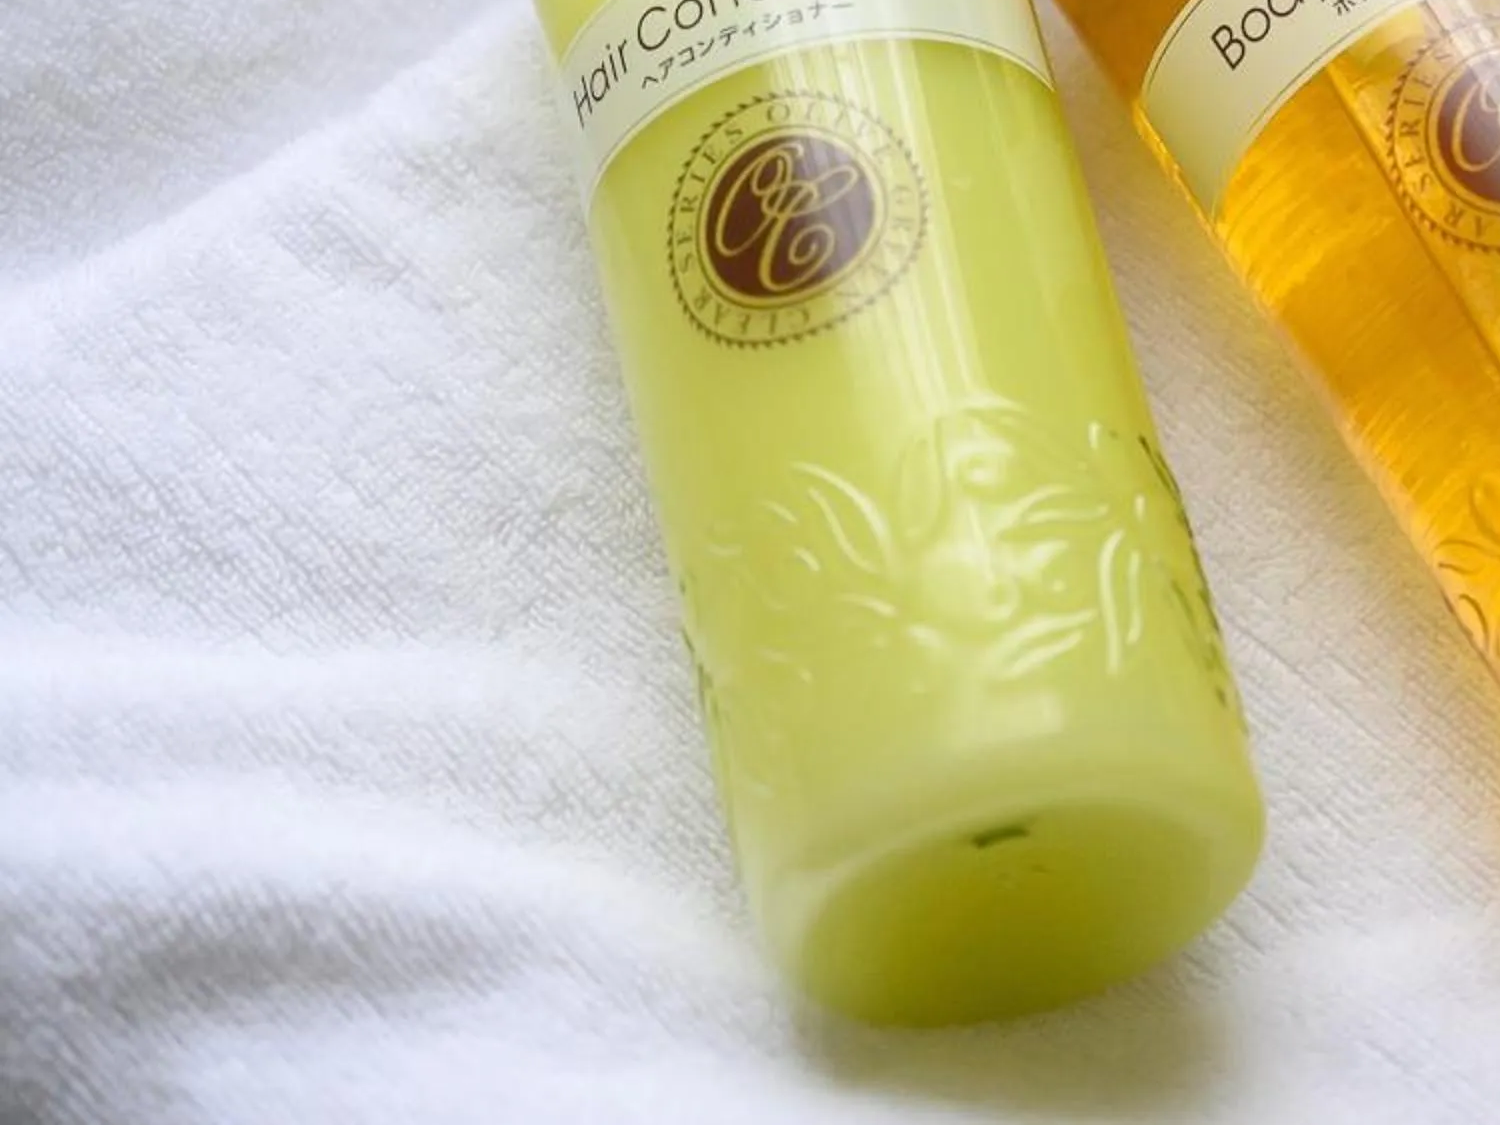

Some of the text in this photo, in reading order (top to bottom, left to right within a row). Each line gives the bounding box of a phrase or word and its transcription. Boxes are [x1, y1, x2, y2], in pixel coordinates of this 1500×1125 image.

[572, 38, 629, 128] Hair
[640, 2, 855, 90] ヘアコンディショナー
